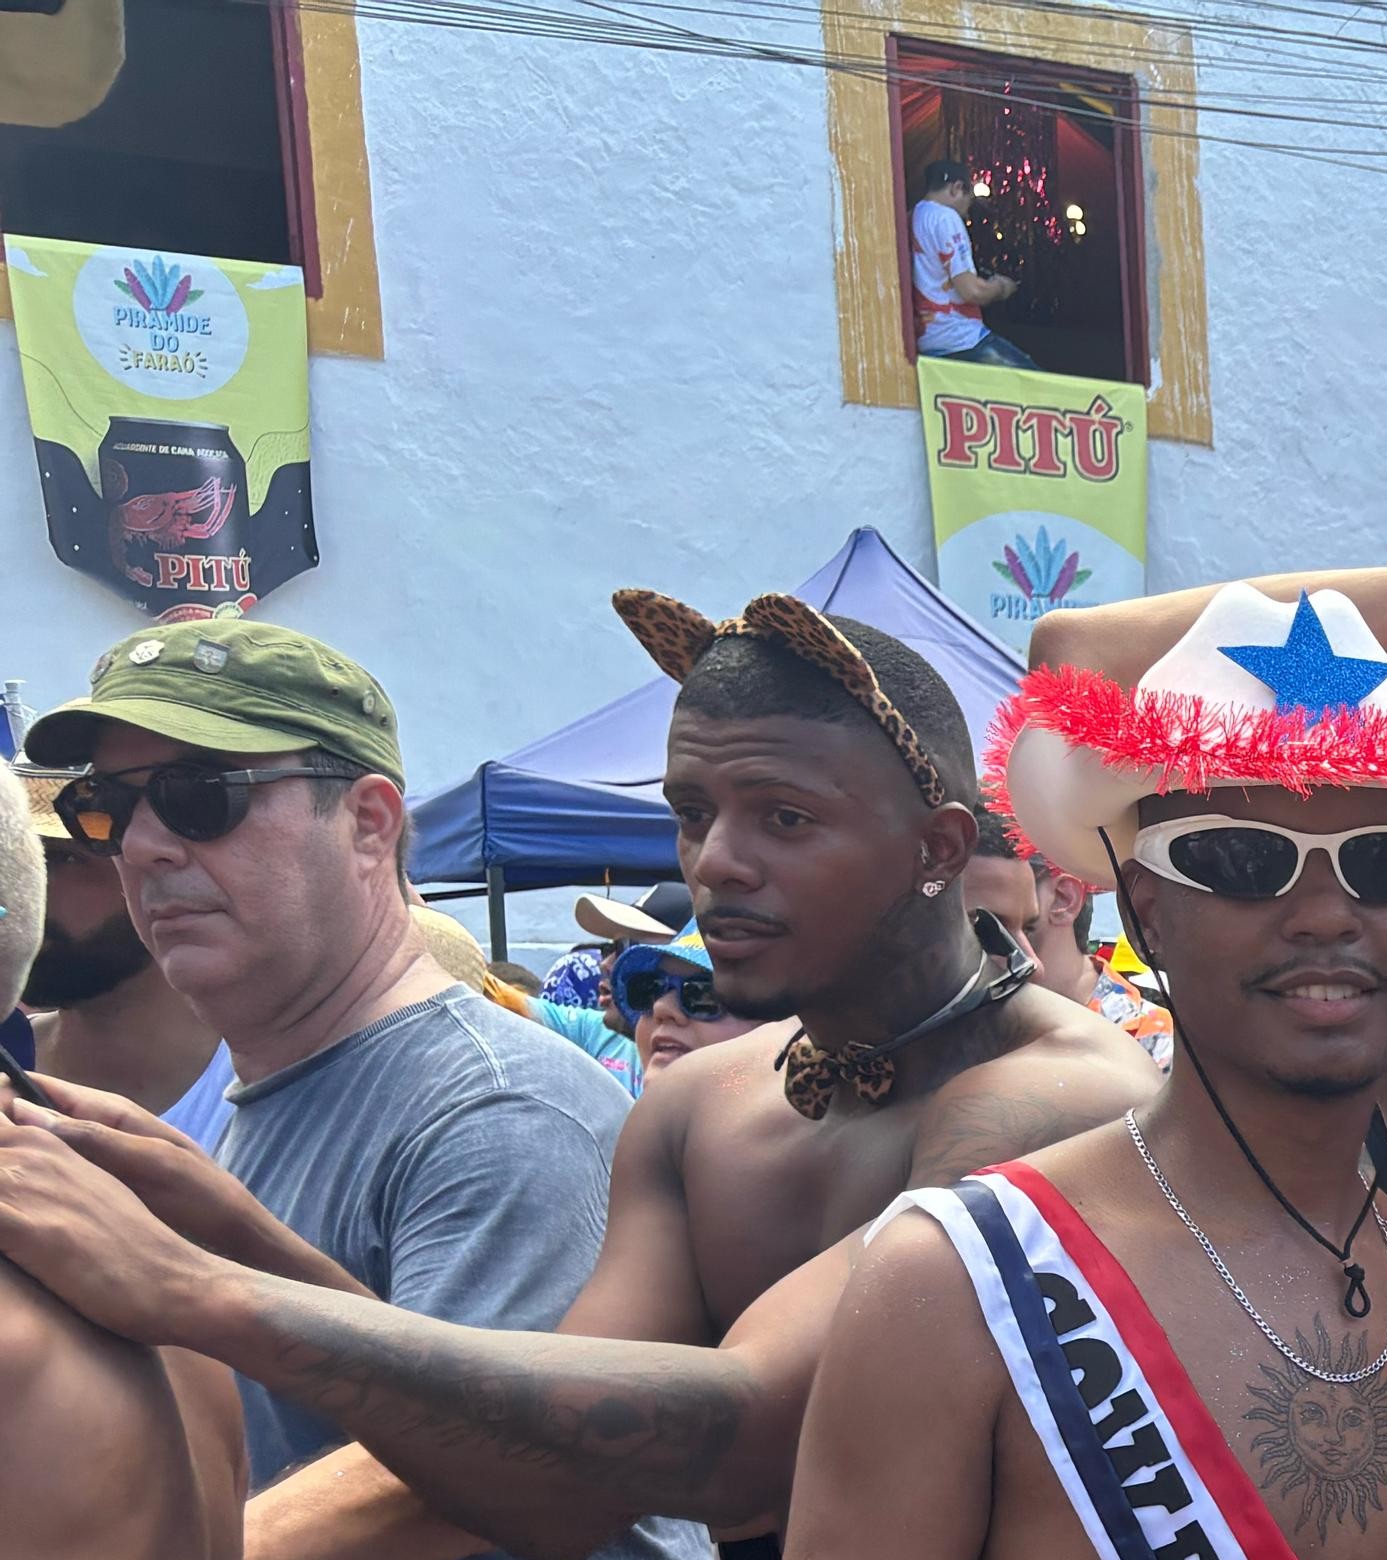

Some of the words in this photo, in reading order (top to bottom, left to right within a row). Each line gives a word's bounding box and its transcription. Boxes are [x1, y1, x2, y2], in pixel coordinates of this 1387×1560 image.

[150, 332, 180, 354] DO
[132, 350, 196, 374] FARAÓ
[934, 394, 1125, 483] PITÚ
[153, 547, 251, 592] PITÚ
